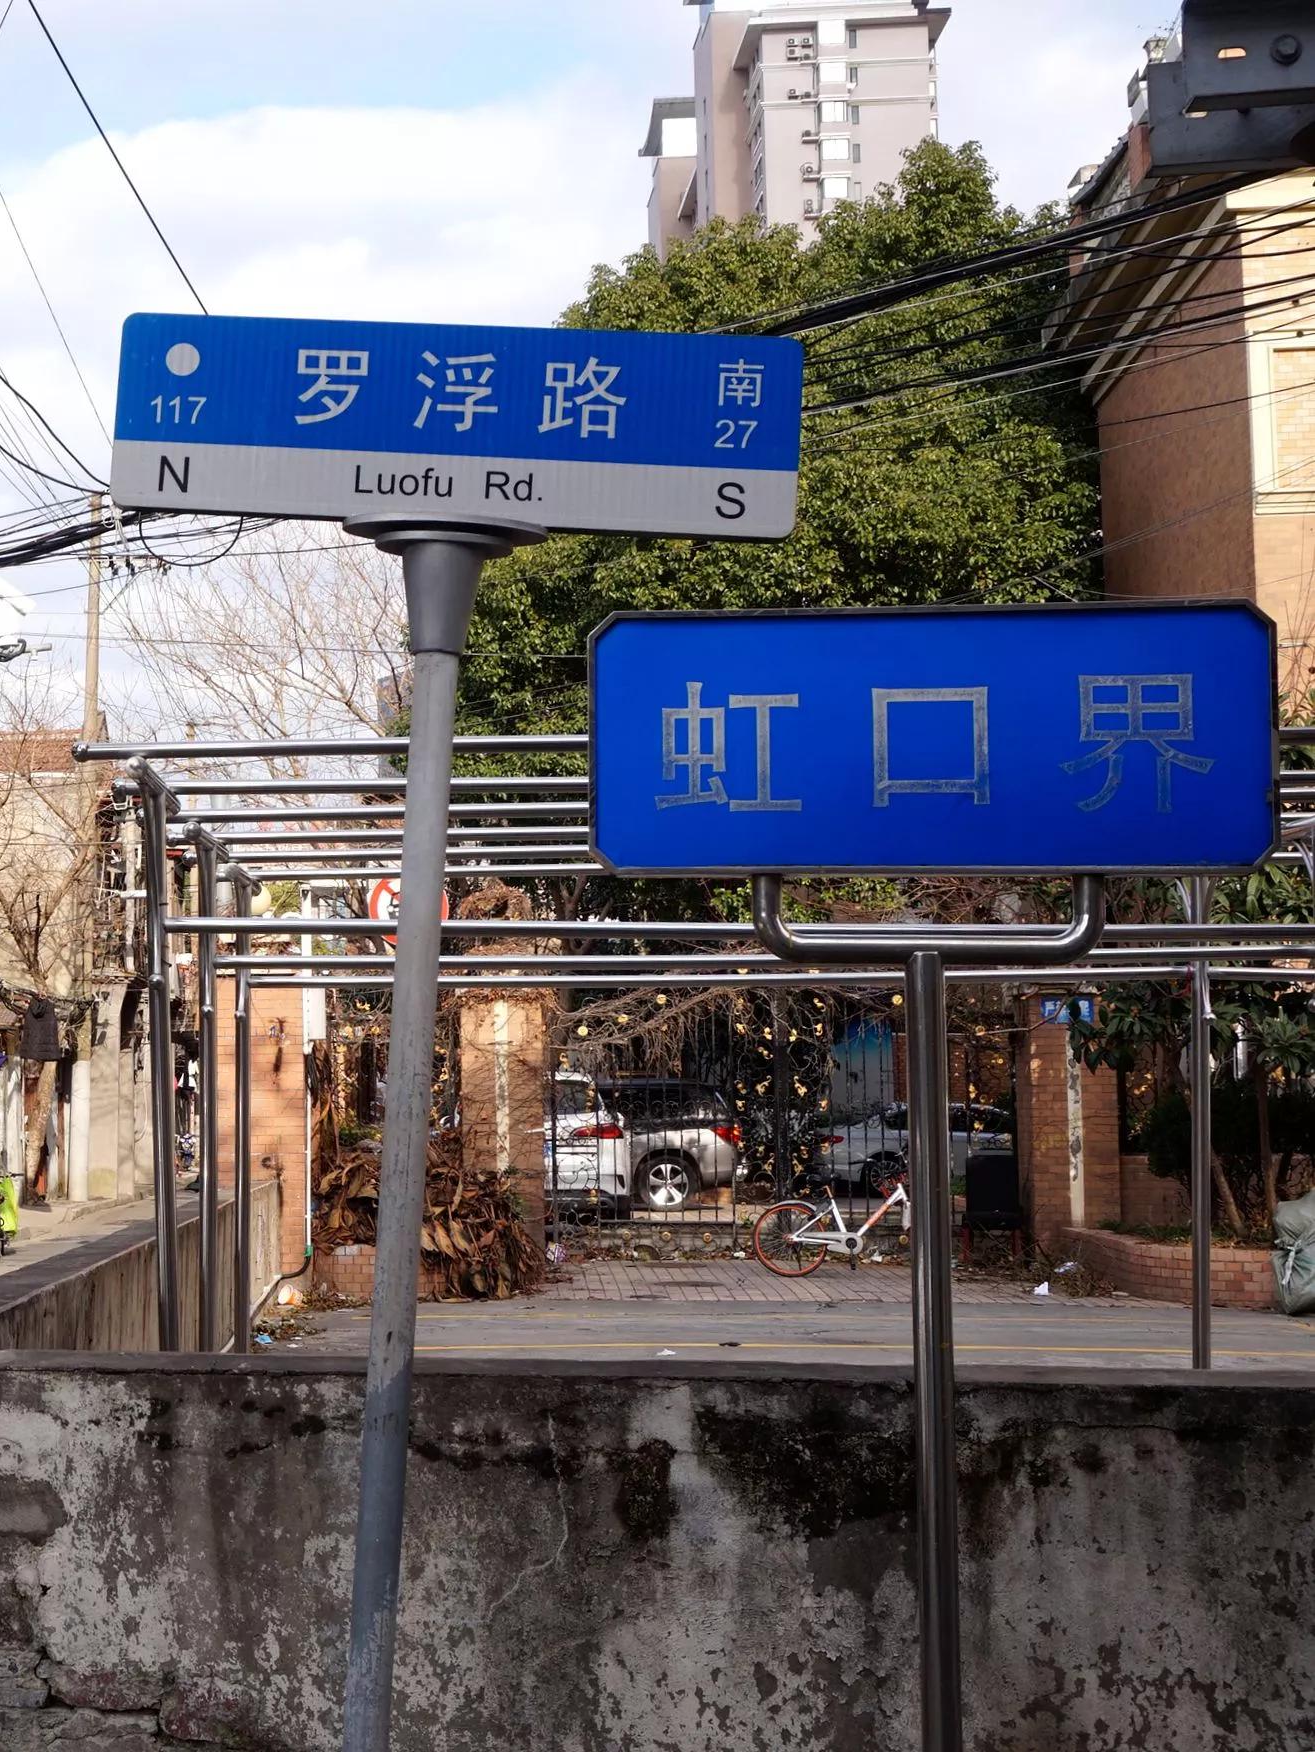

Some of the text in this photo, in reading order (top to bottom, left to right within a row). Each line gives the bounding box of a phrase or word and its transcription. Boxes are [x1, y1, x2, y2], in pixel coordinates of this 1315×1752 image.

[294, 346, 627, 440] 罗浮路
[717, 358, 765, 408] 南
[150, 394, 207, 425] 117
[714, 420, 757, 449] 27
[157, 455, 191, 494] N
[353, 464, 543, 502] Luofu Rd.
[715, 483, 747, 519] S
[654, 673, 1216, 813] 虹口界
